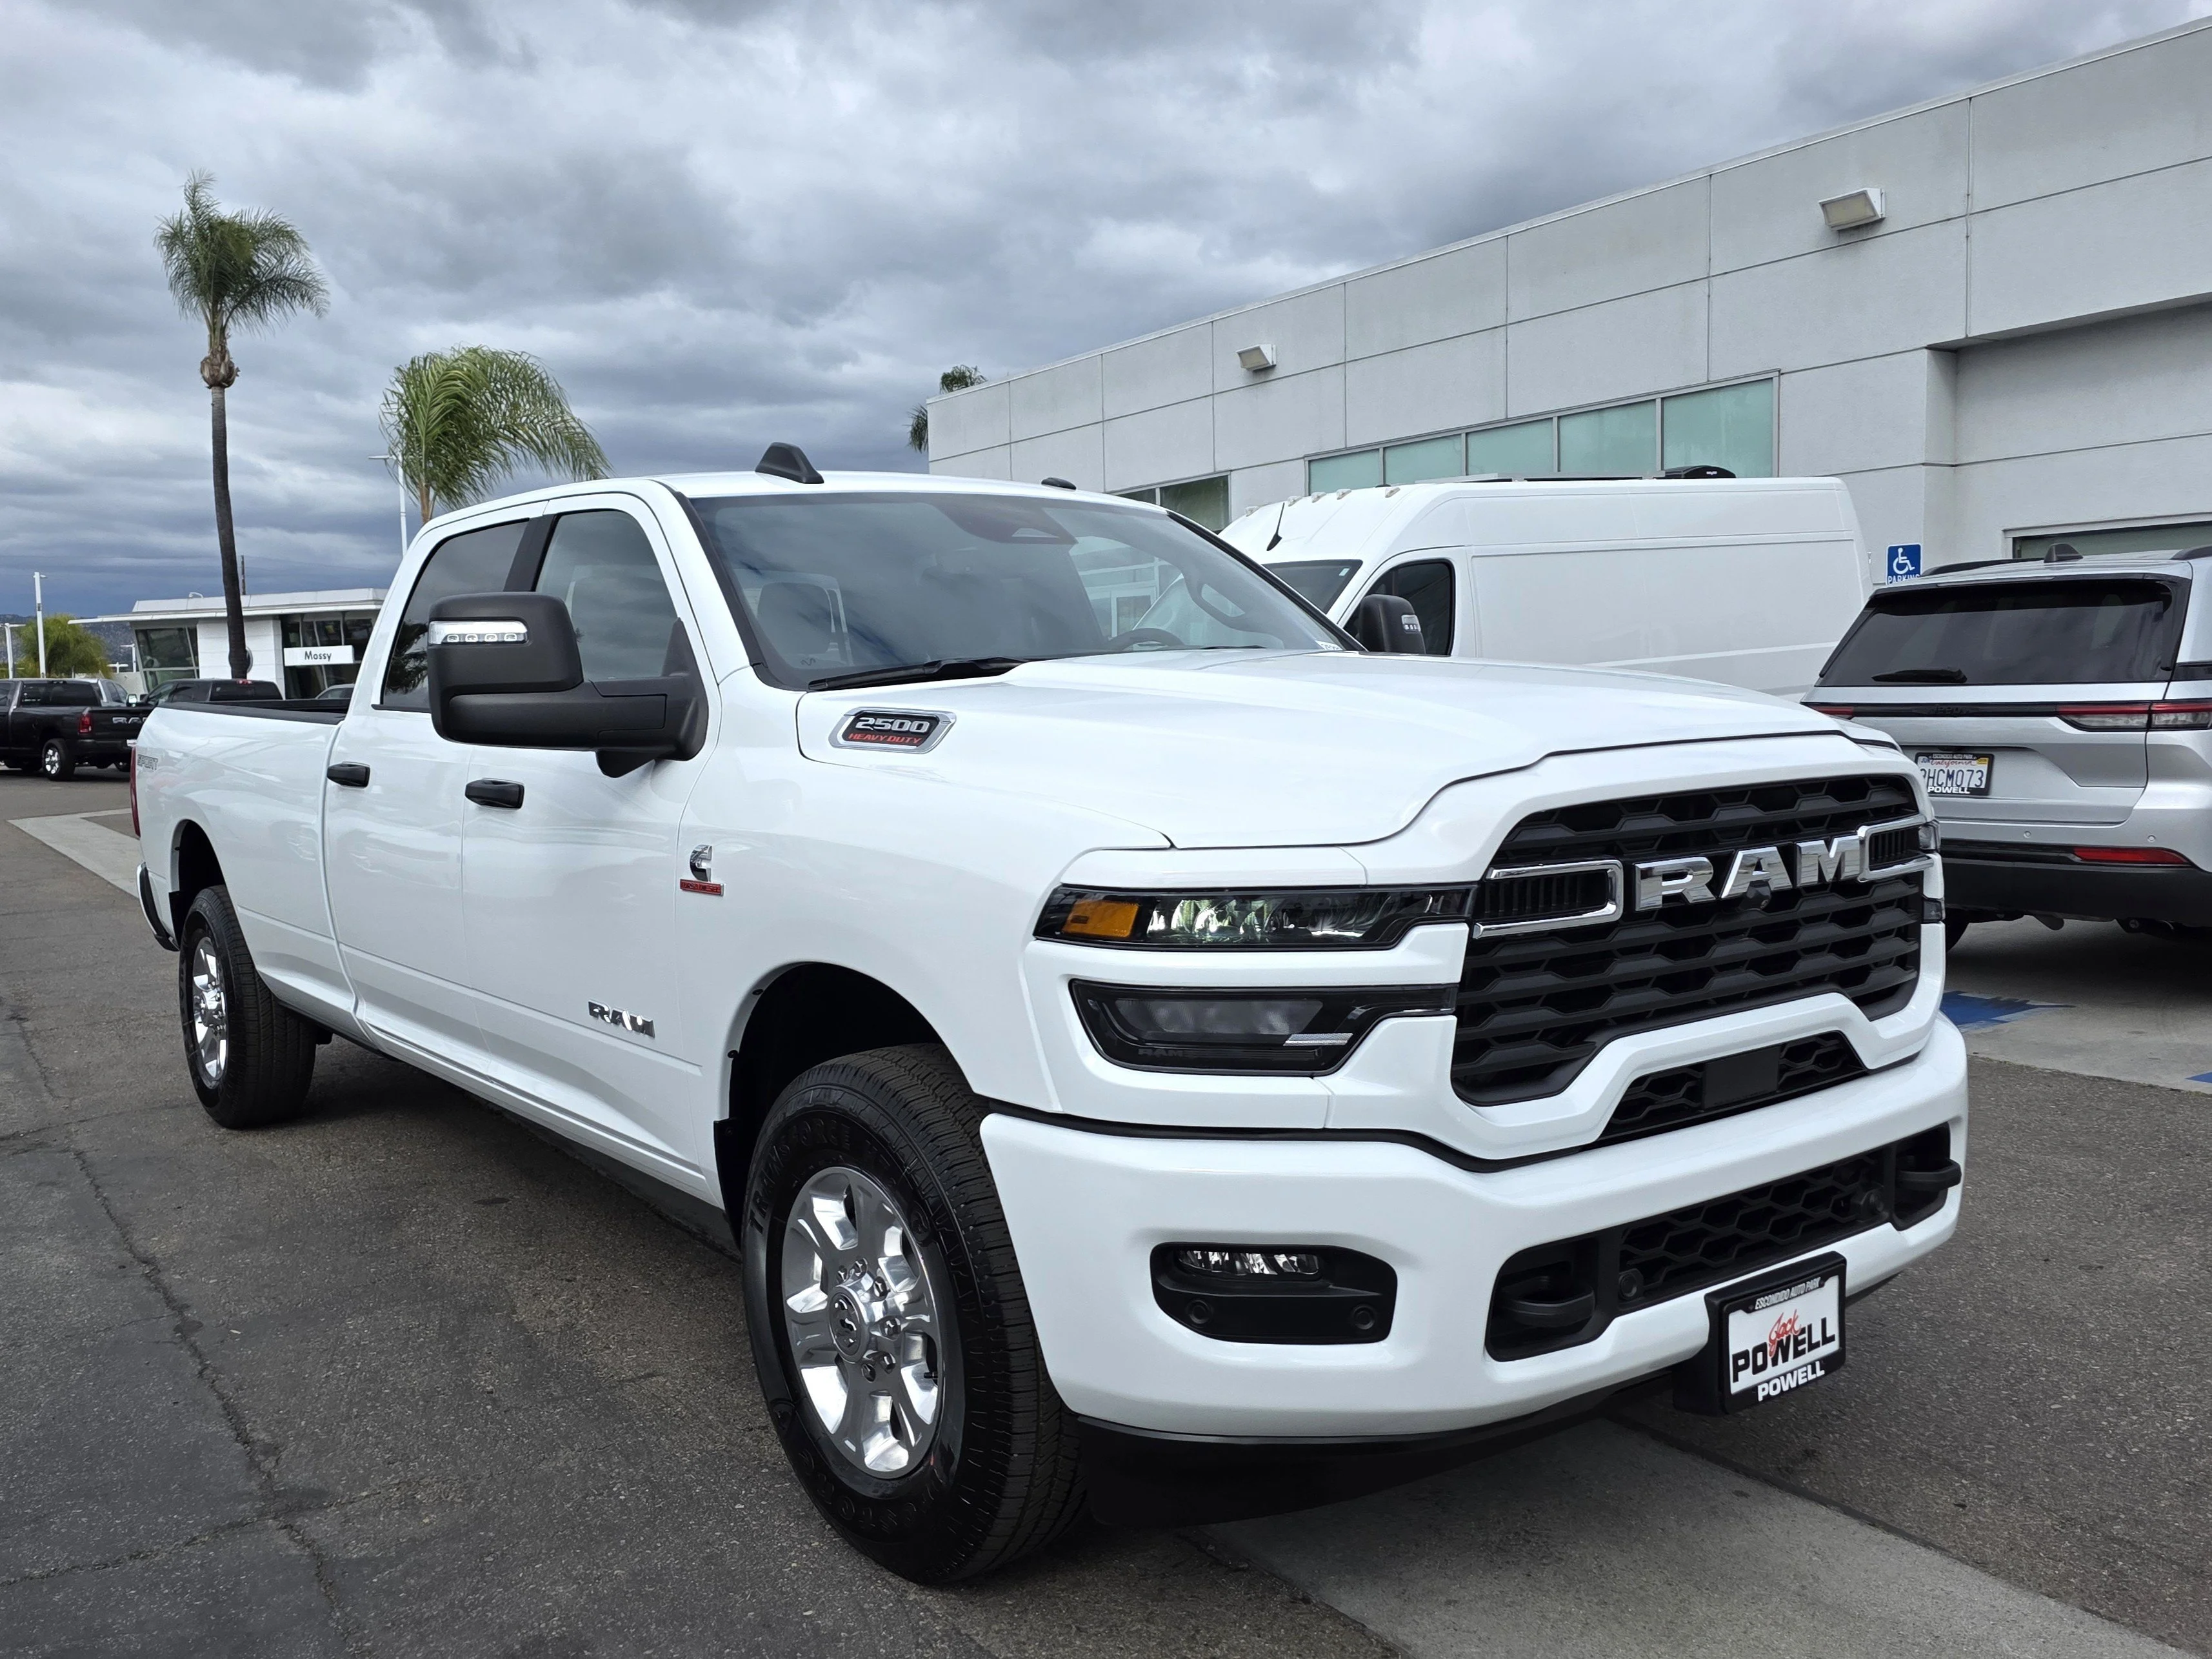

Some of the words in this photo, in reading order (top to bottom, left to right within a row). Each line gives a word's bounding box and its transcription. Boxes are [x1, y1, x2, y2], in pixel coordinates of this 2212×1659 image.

[304, 650, 332, 661] Mossy
[848, 733, 888, 741] HEAVY
[855, 717, 930, 732] 2500
[1929, 759, 1977, 768] California
[1635, 834, 1861, 911] RAM
[588, 1000, 655, 1038] RAM
[1732, 1317, 1835, 1383] POWELL
[1768, 1309, 1802, 1358] Jack
[1757, 1361, 1825, 1401] POWELL
